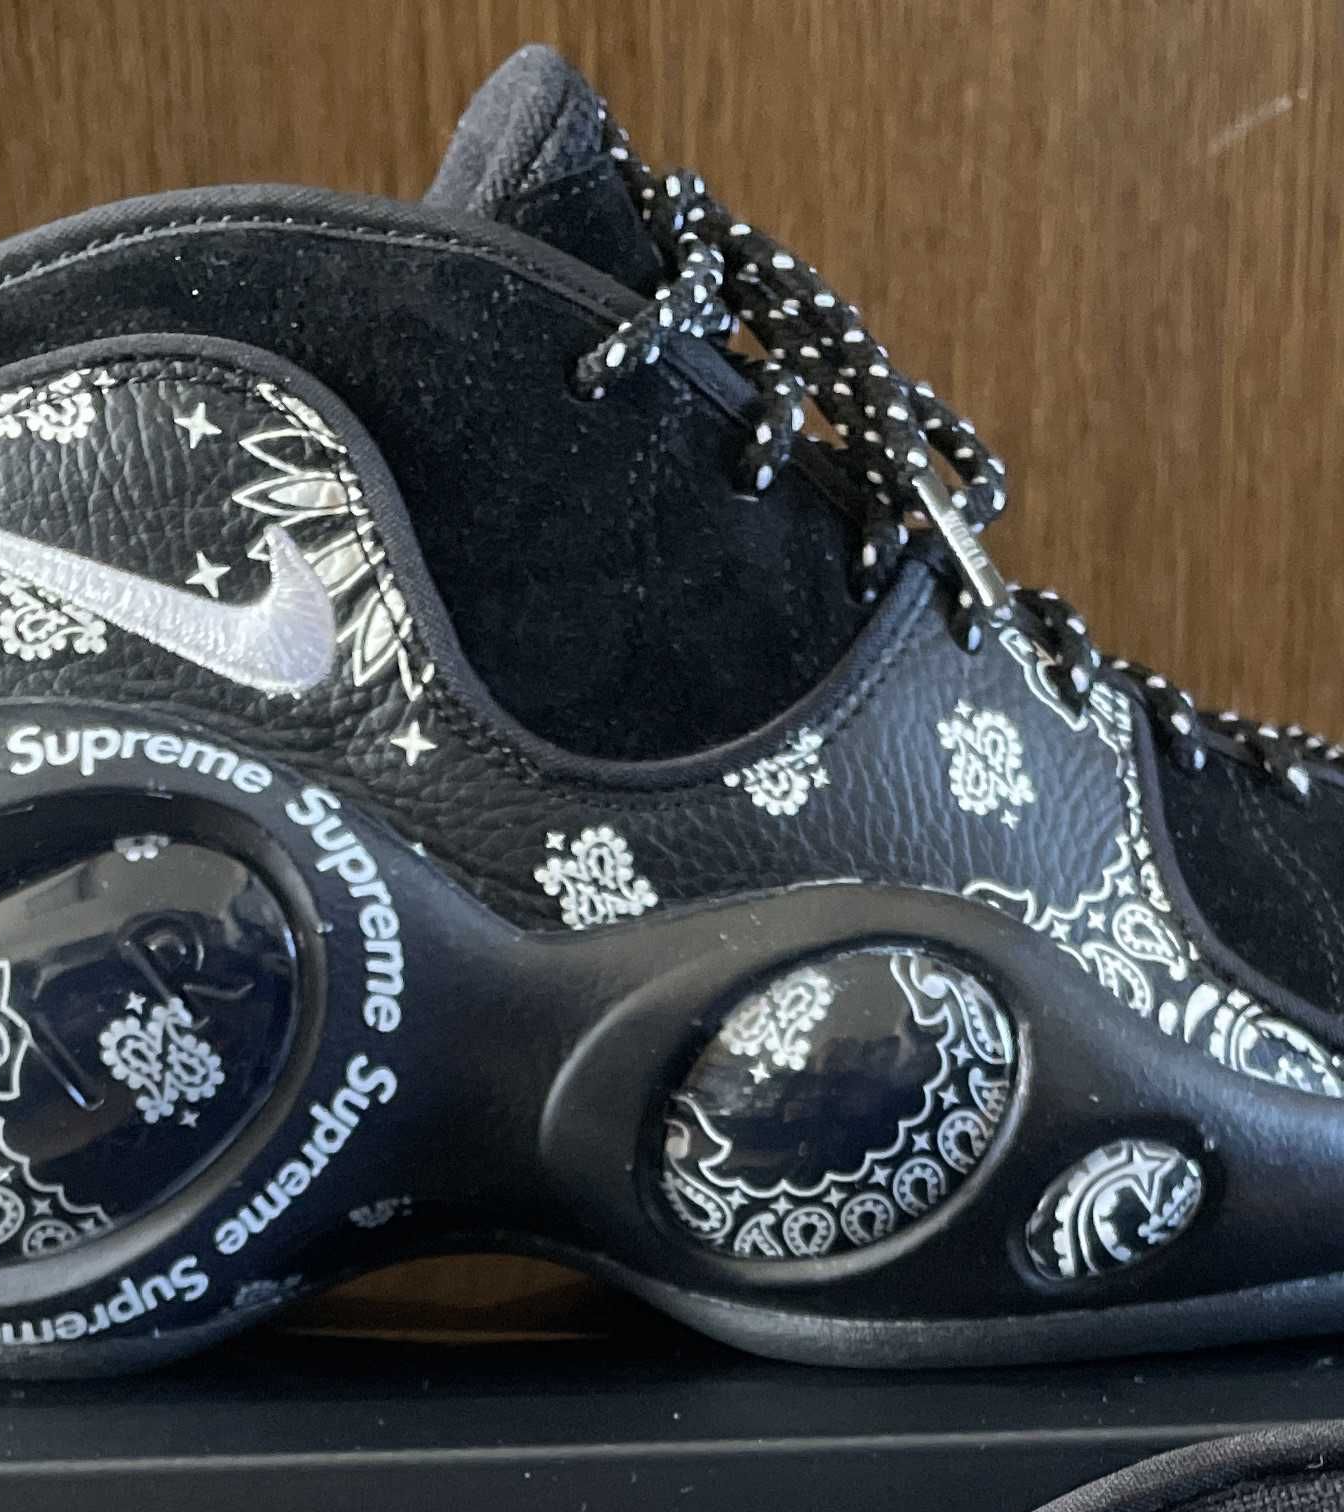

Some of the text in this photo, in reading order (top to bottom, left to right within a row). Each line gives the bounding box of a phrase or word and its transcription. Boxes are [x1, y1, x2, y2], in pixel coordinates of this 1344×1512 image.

[7, 724, 273, 793] Supreme
[284, 786, 404, 1032] Supreme
[215, 1054, 398, 1256] Supreme
